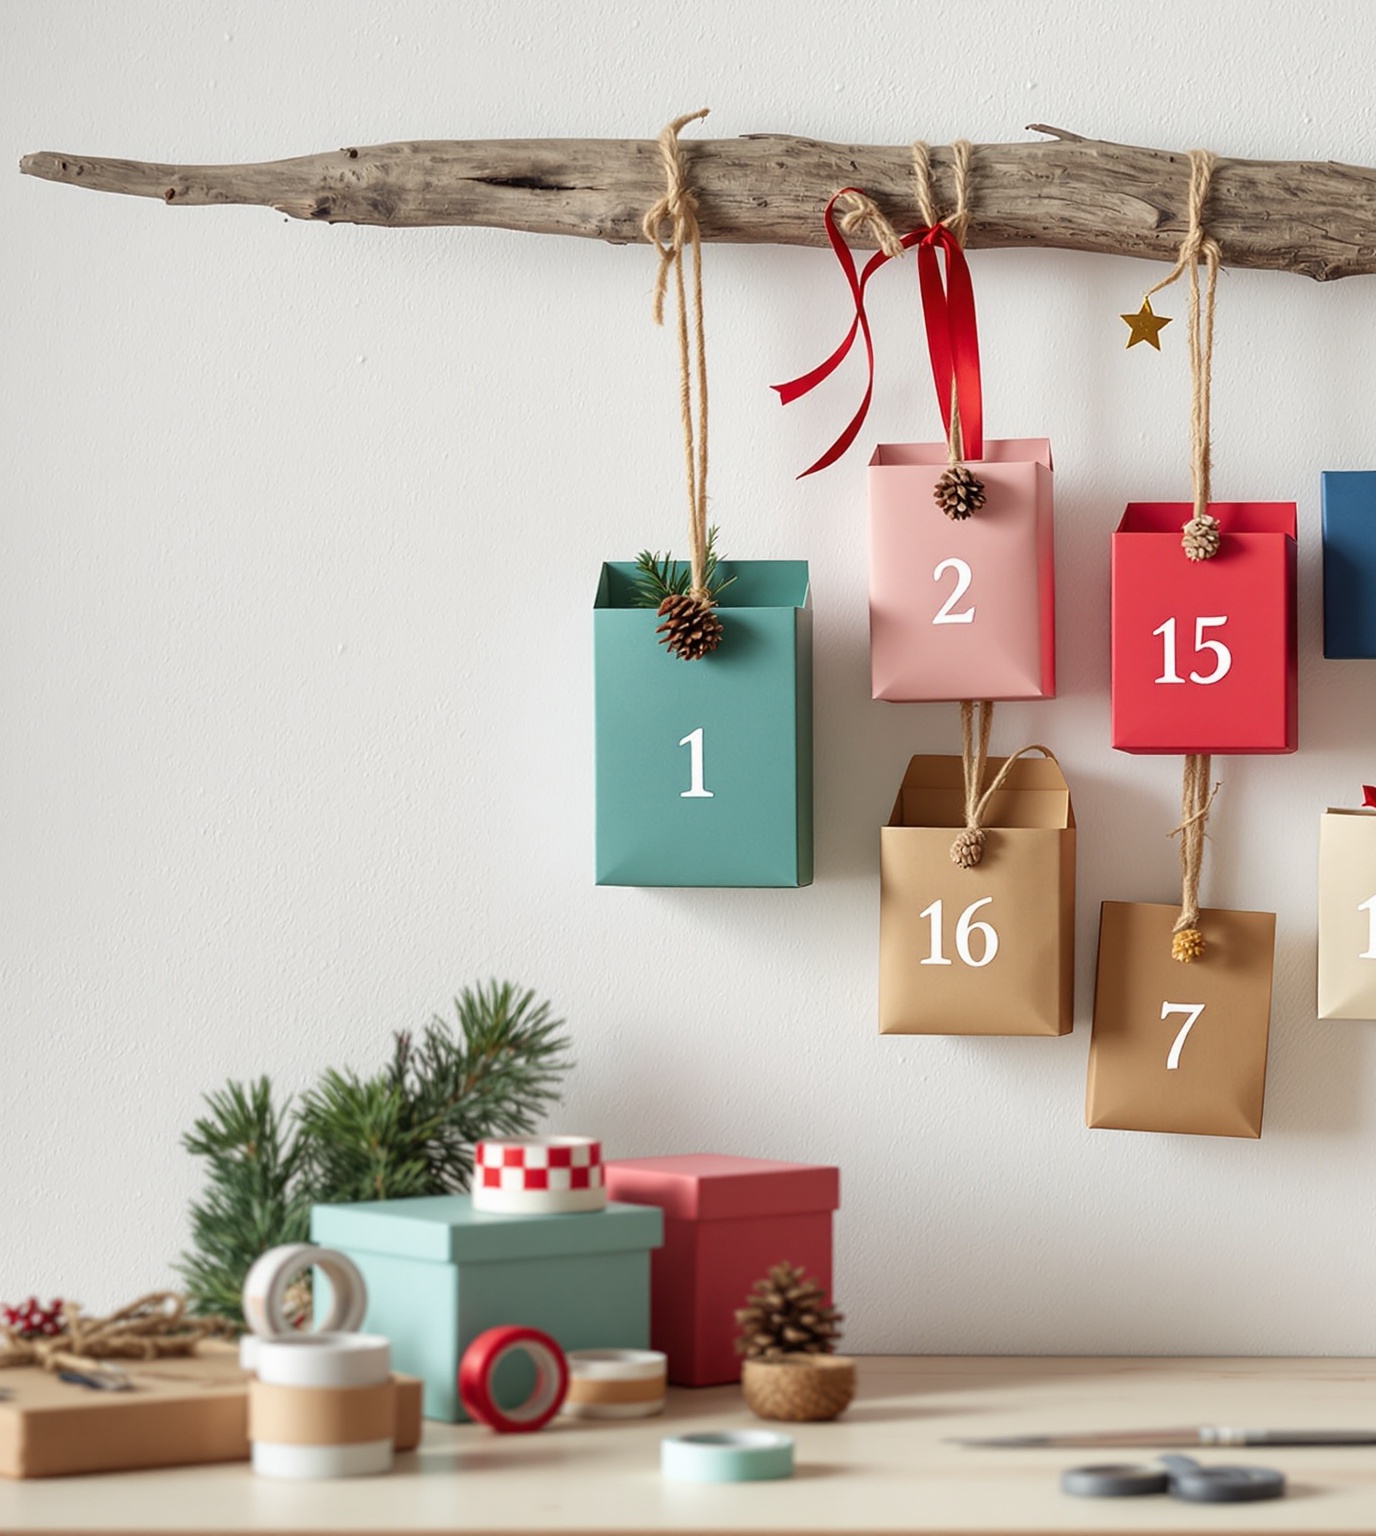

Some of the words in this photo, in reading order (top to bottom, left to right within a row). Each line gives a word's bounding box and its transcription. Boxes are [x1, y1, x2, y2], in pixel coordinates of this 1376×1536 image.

[932, 557, 975, 625] 2
[1152, 615, 1232, 685] 15
[679, 727, 714, 798] 1
[919, 896, 999, 967] 16
[1160, 1001, 1205, 1070] 7
